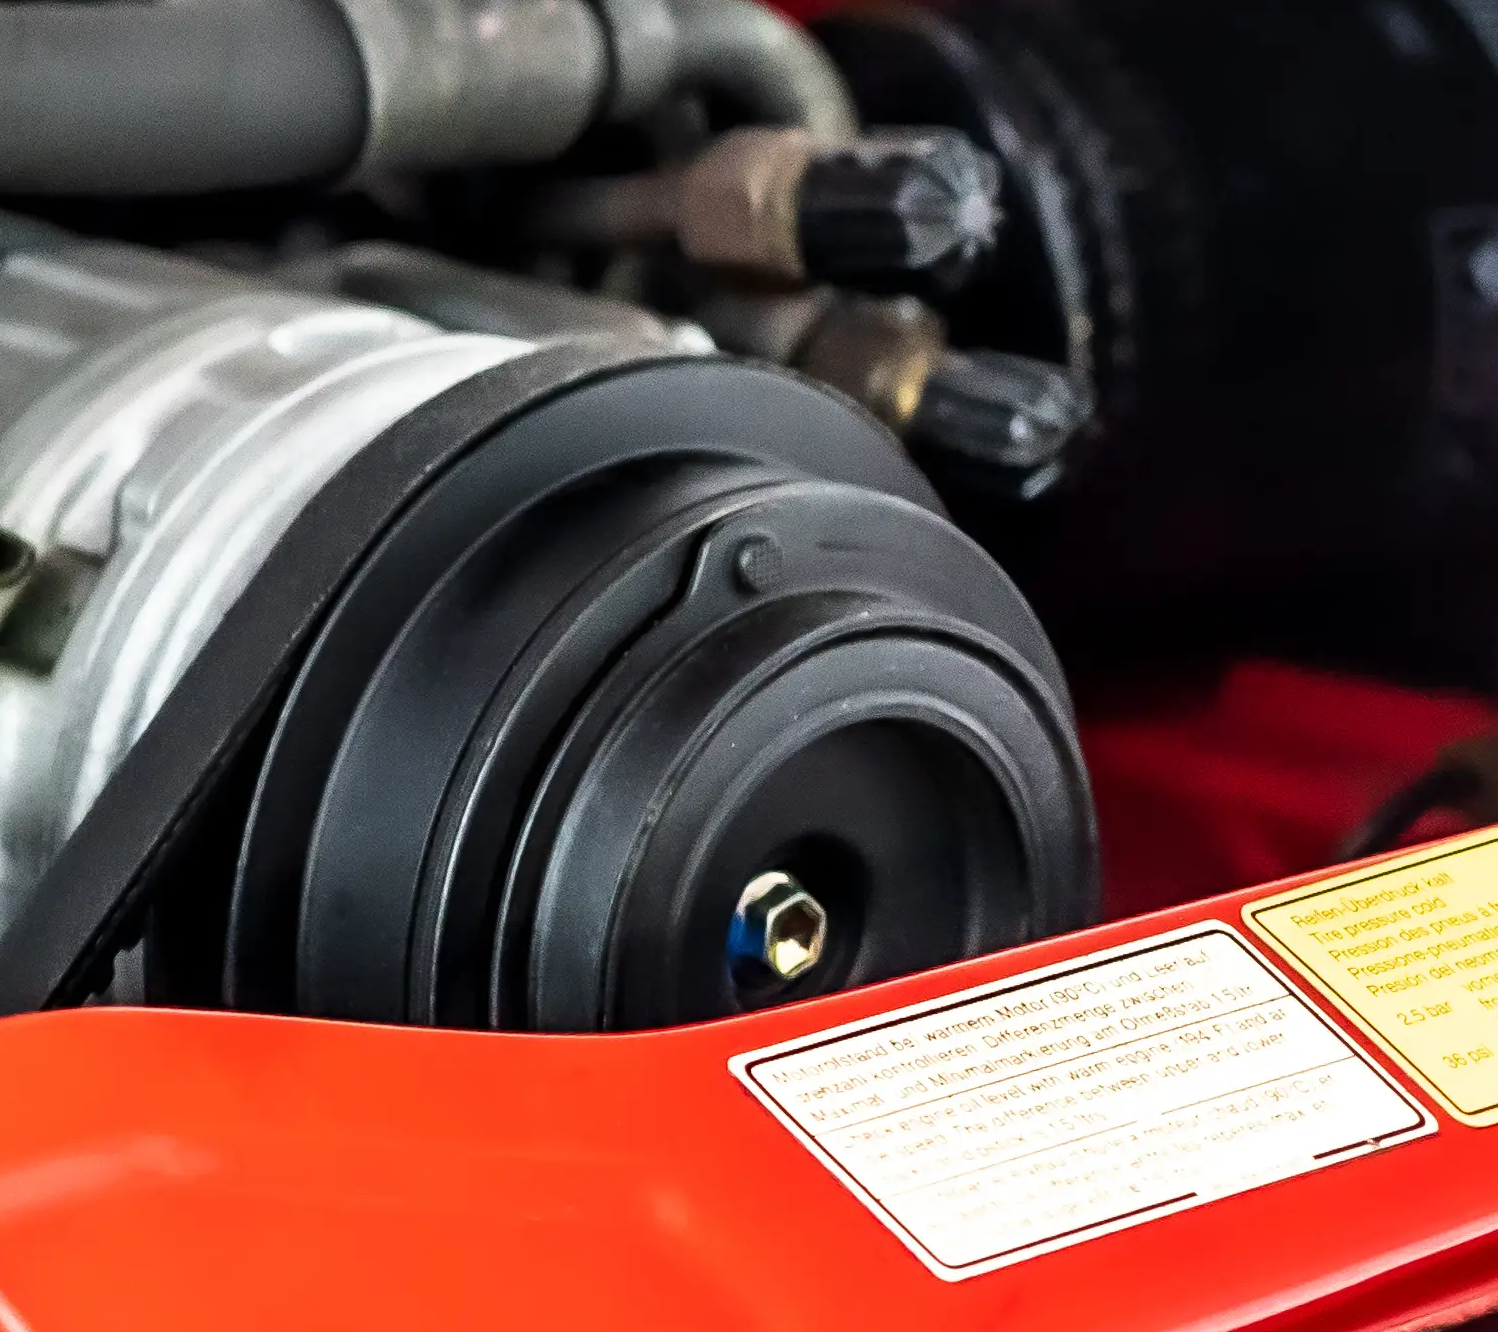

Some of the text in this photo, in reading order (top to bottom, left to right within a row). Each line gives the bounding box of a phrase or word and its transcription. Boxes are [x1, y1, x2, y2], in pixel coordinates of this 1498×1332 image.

[1308, 896, 1447, 945] Tire pressure cold
[1328, 935, 1398, 962] Pression
[1399, 926, 1430, 942] des
[1429, 912, 1478, 935] pneus
[1429, 962, 1456, 979] del
[992, 997, 1051, 1022] Motor
[1108, 968, 1144, 989] und
[1423, 1001, 1453, 1017] bar
[1089, 1022, 1121, 1042] am
[1443, 1044, 1493, 1068] 36 psi
